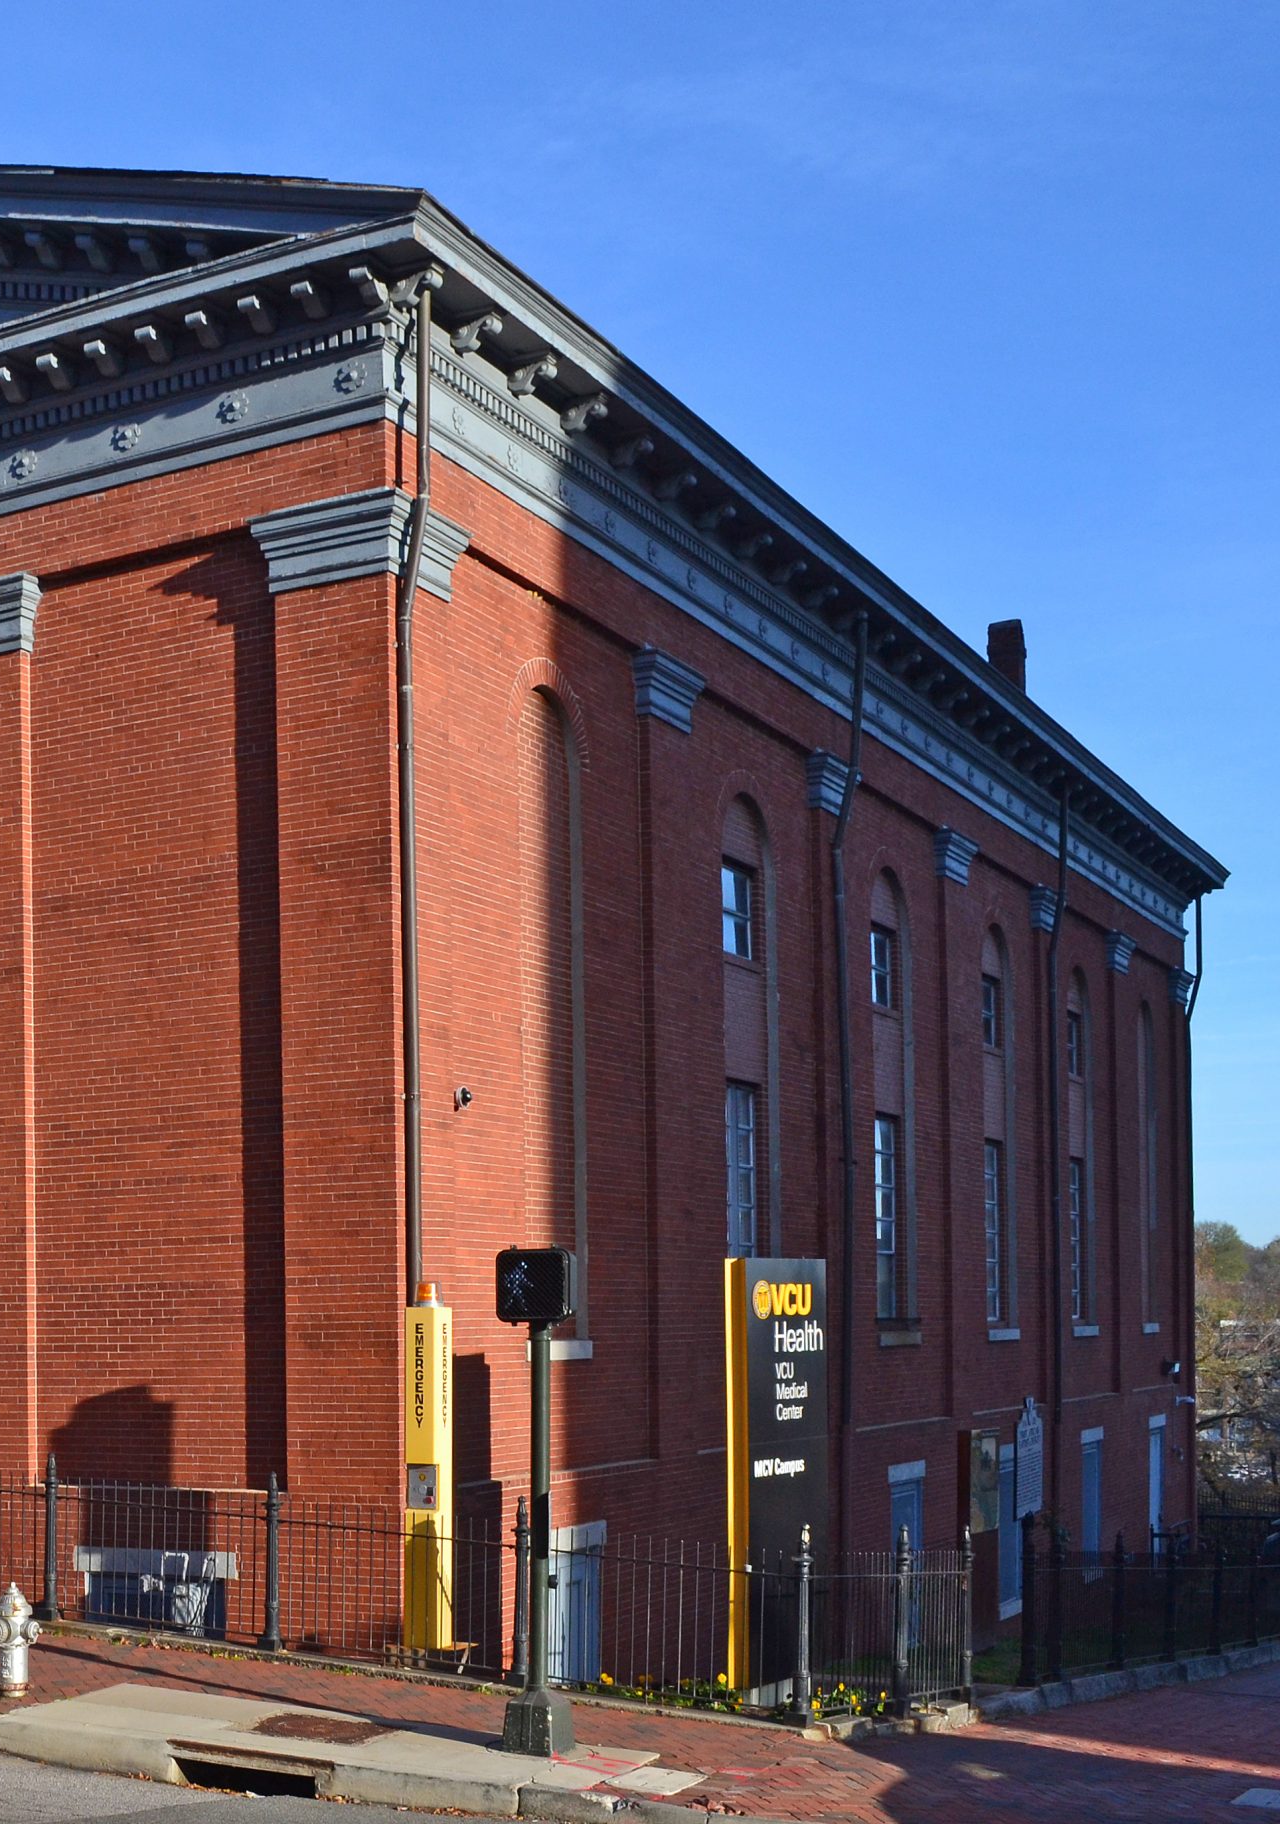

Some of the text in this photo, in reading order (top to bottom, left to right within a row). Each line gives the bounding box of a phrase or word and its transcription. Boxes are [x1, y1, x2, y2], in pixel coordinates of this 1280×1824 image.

[770, 1283, 812, 1316] VCU
[774, 1320, 824, 1352] Health
[415, 1323, 424, 1428] EMERGENCY
[775, 1362, 794, 1379] VCU
[776, 1382, 808, 1400] Medical
[776, 1404, 804, 1421] Center
[754, 1457, 805, 1478] MCV Campus
